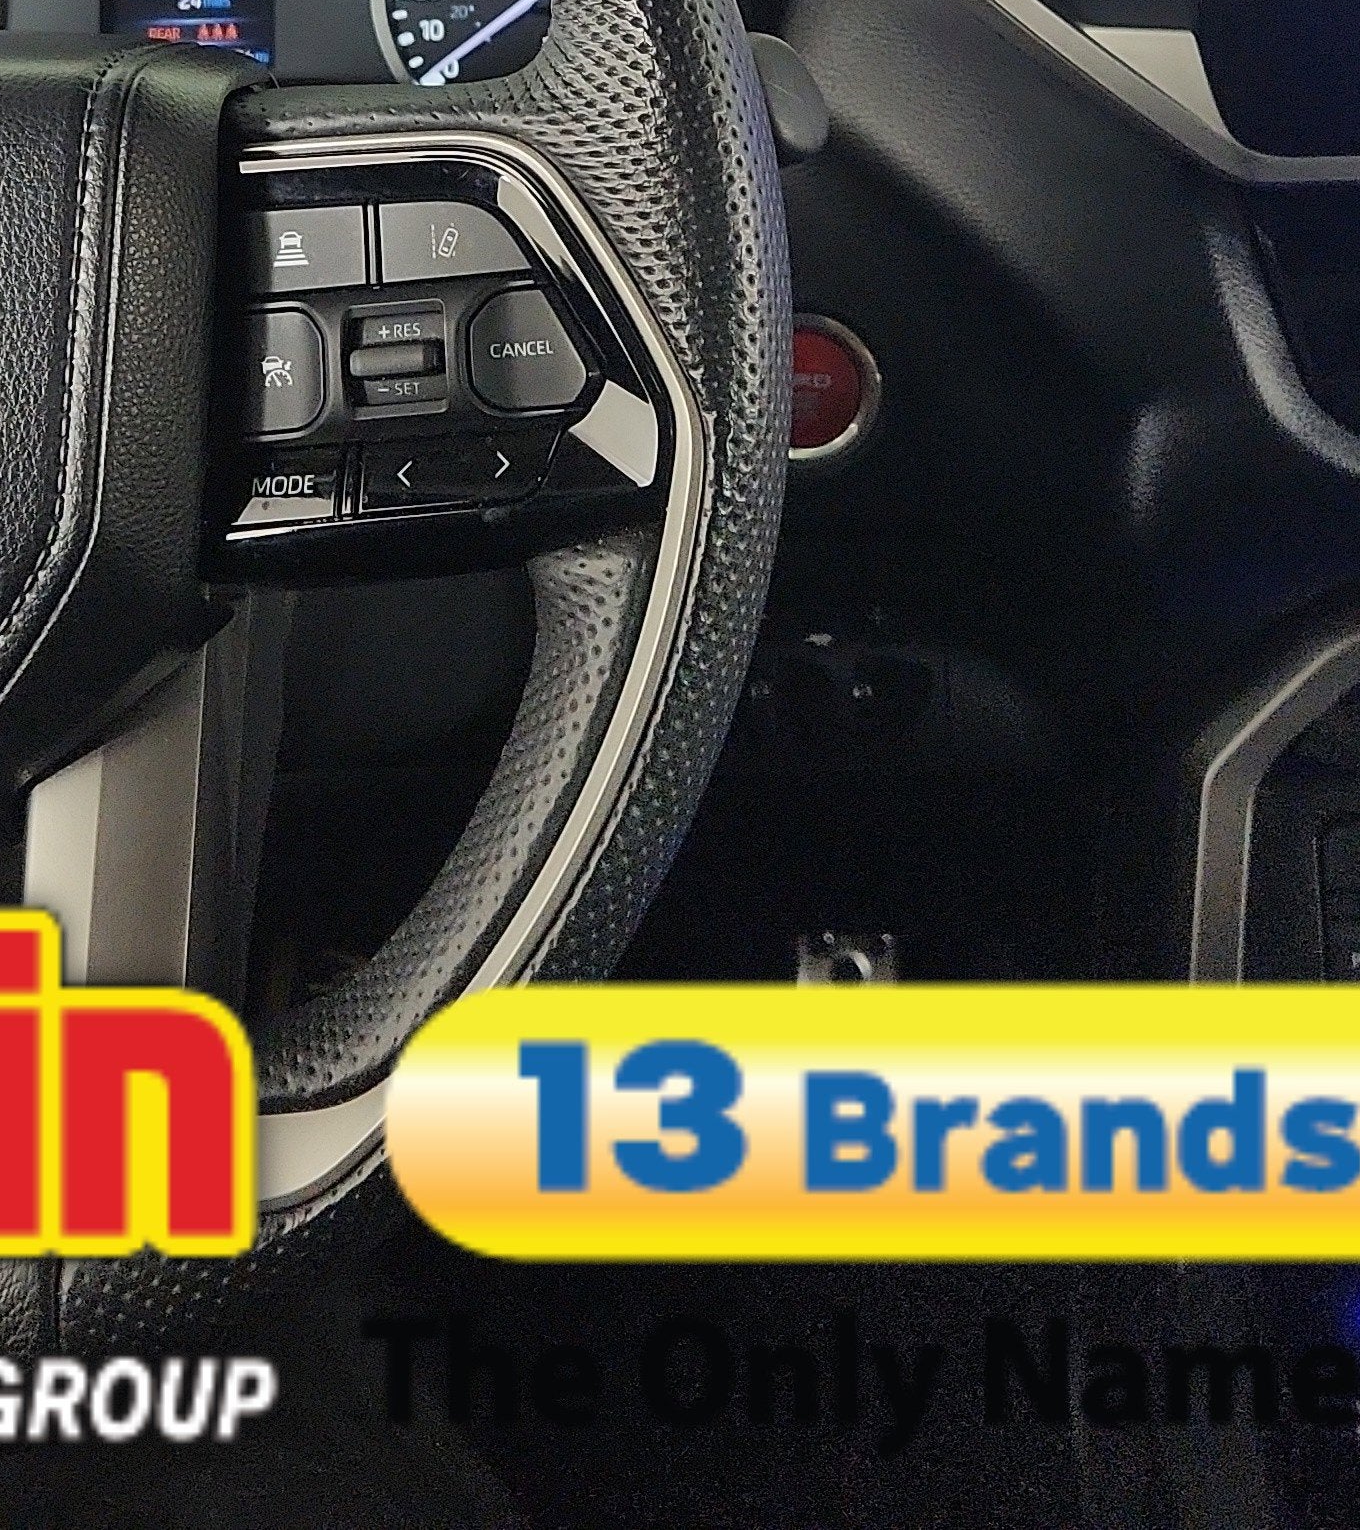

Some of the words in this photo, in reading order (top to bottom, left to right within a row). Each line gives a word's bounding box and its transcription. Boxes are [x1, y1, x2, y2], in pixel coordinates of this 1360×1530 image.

[419, 19, 445, 42] 10
[489, 340, 554, 359] CANCEL
[251, 474, 316, 497] MODE
